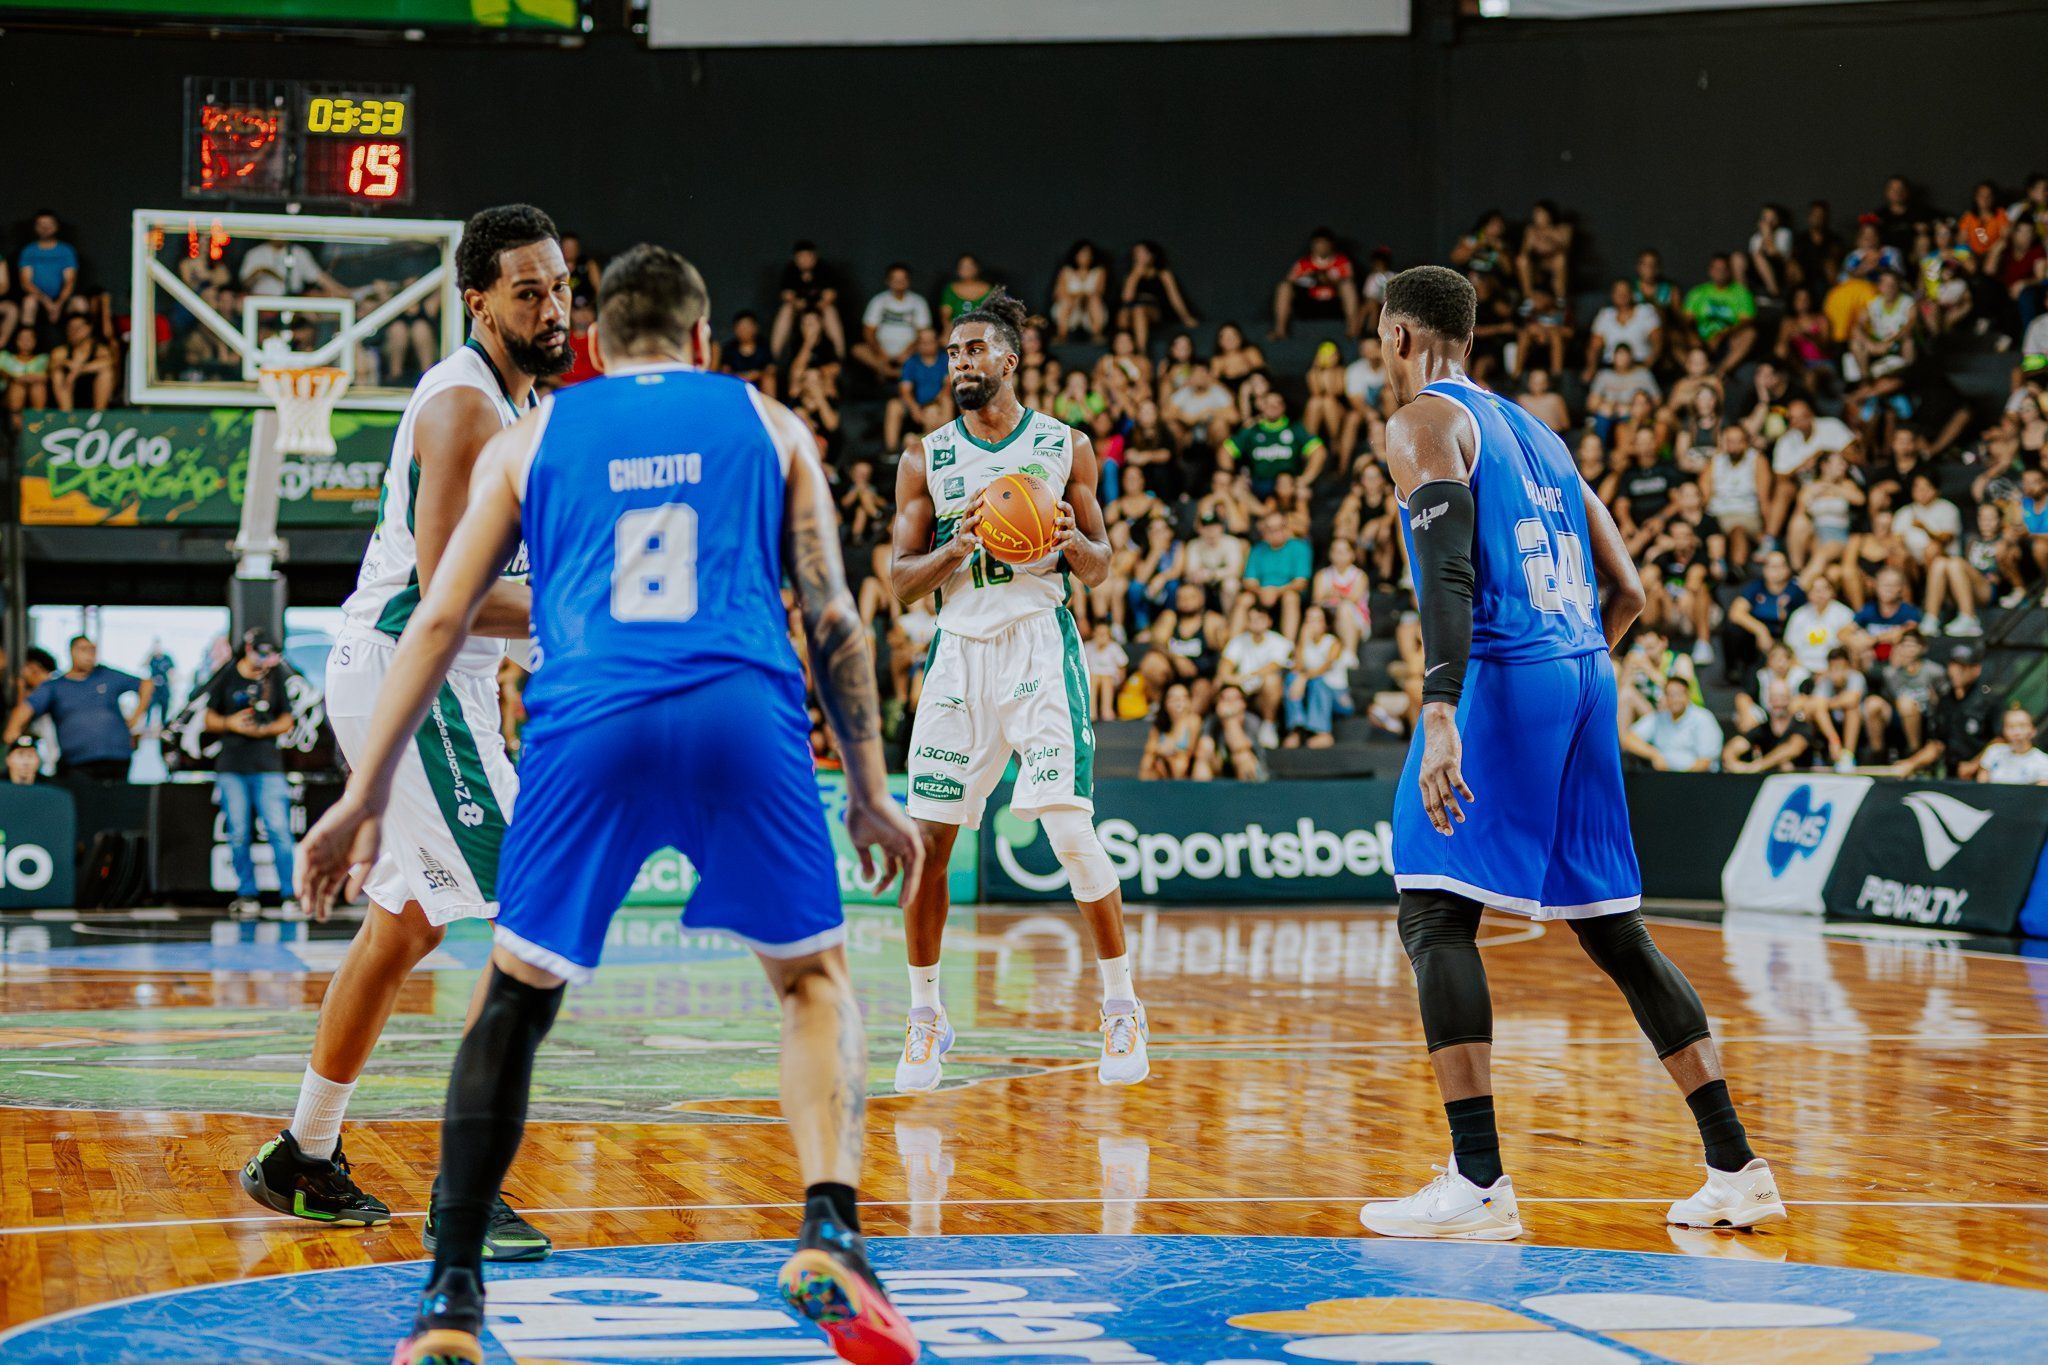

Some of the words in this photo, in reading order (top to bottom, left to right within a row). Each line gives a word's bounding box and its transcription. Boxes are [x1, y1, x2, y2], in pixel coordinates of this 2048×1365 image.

[307, 98, 405, 135] 03:33
[349, 144, 401, 196] 15
[311, 462, 385, 489] FAST
[608, 453, 702, 492] CHUZITO
[980, 516, 1023, 548] ALTY
[610, 502, 699, 623] 8
[969, 548, 1014, 588] 16
[1514, 517, 1594, 628] 24
[915, 781, 961, 796] MEZZANI
[1096, 817, 1394, 895] Sportsbet
[1856, 874, 1969, 925] PENALTY
